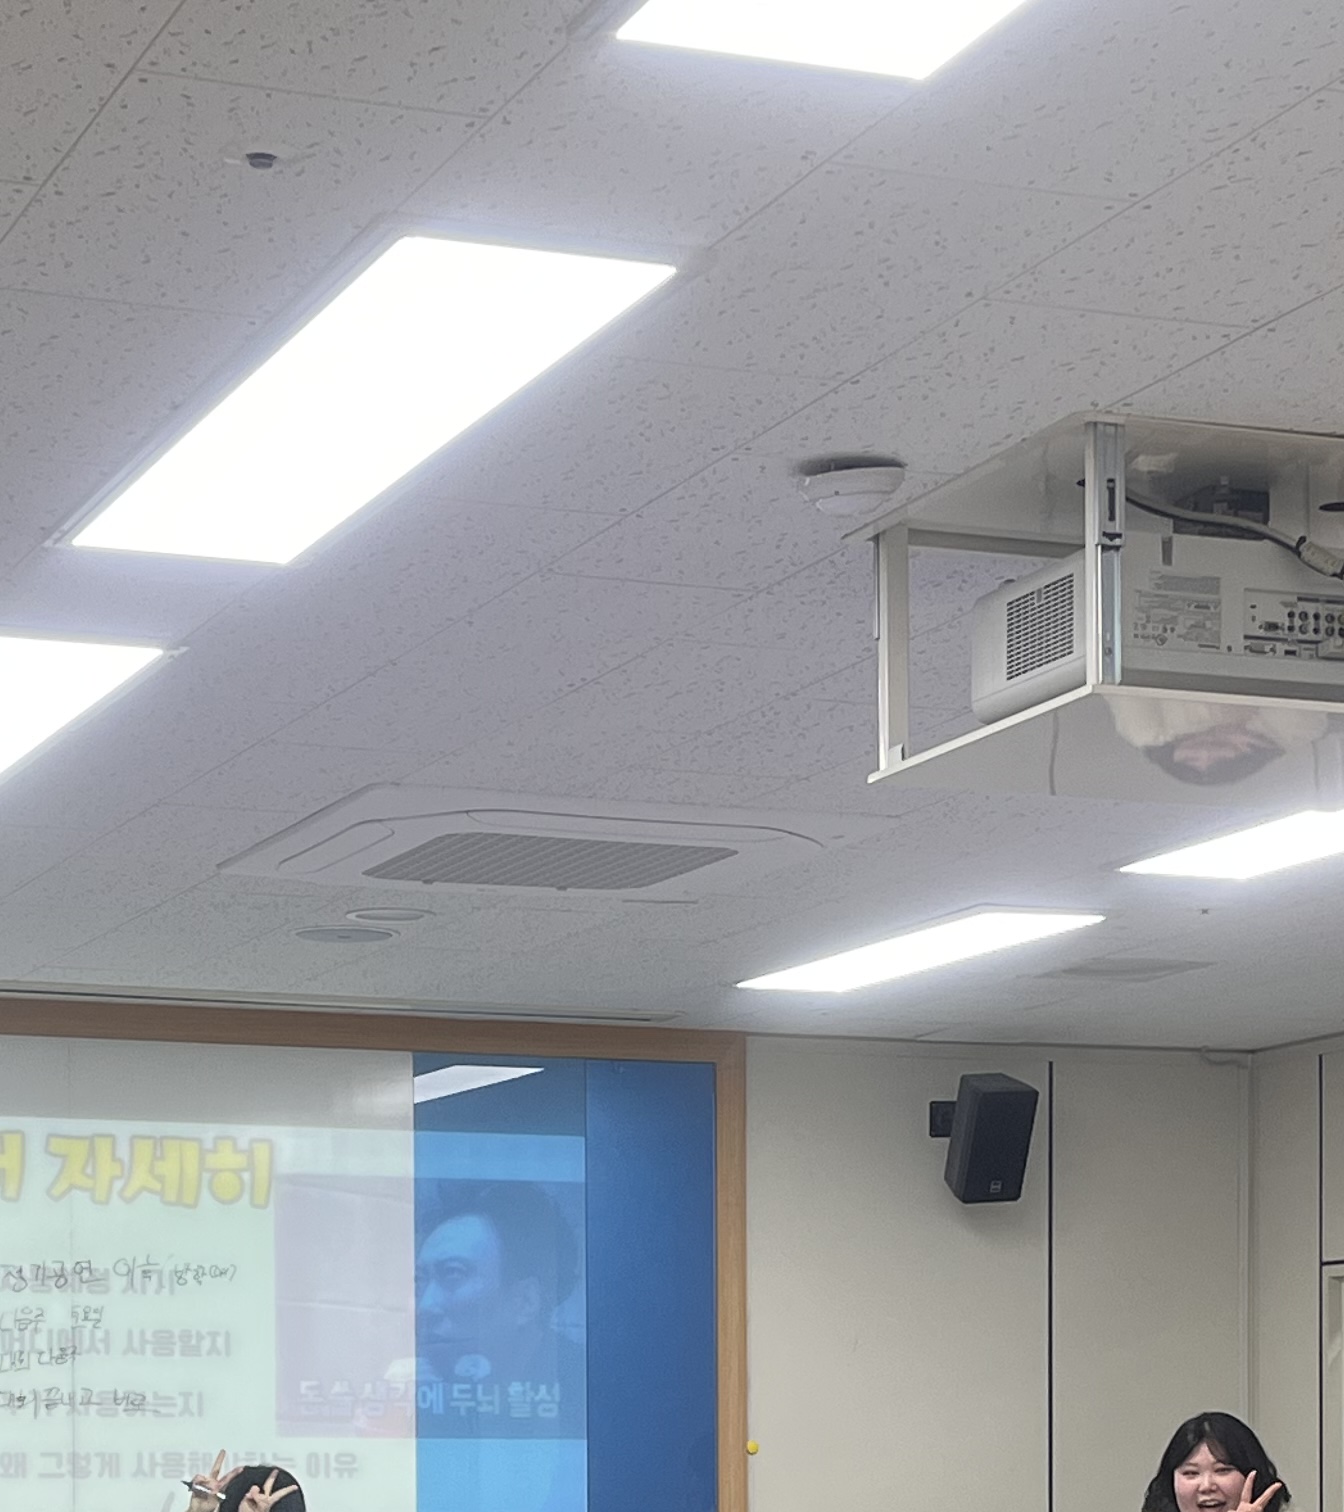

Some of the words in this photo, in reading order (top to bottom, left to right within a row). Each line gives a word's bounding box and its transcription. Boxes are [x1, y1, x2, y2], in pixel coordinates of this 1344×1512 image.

[45, 1130, 273, 1209] 자세히
[121, 1328, 231, 1358] 사용할지
[0, 1452, 28, 1479] 왜
[39, 1452, 120, 1479] 그렇게
[306, 1452, 358, 1479] 이유
